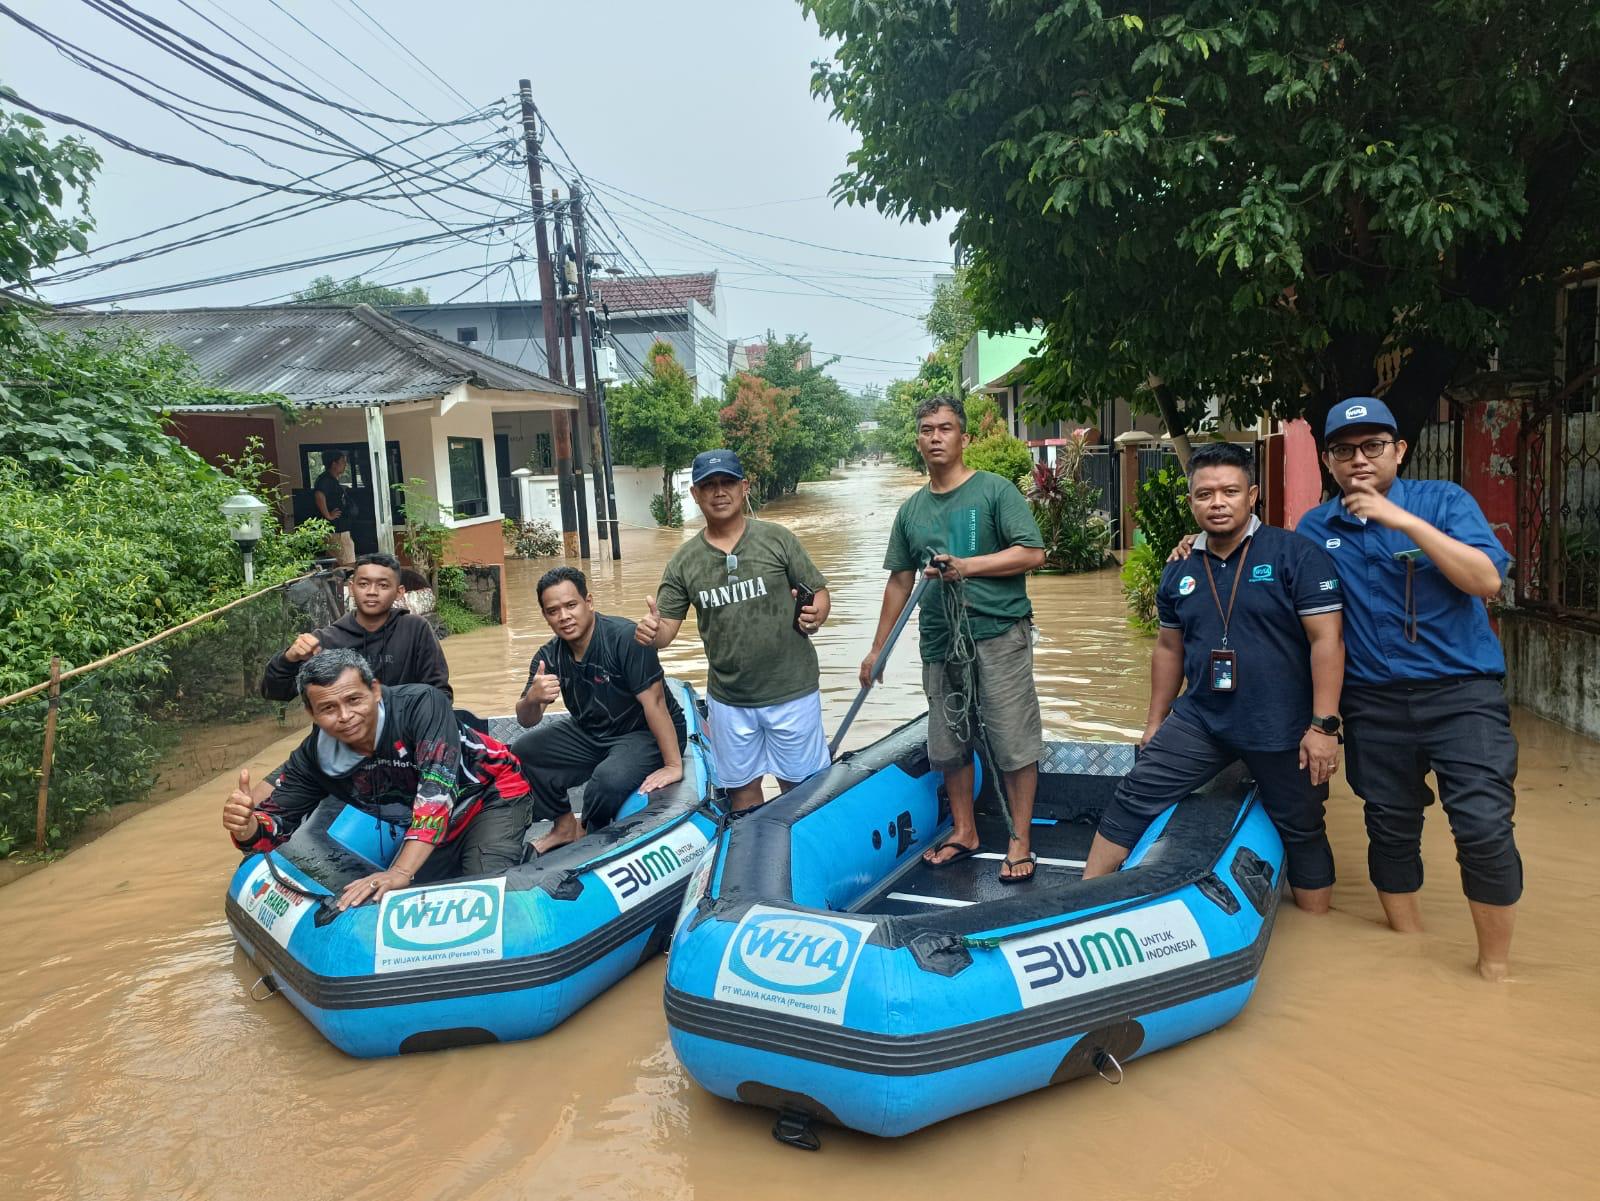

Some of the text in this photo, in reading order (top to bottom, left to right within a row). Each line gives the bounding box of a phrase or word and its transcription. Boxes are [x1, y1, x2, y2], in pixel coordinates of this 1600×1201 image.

[699, 576, 768, 609] PANITIA
[675, 842, 694, 856] UNTUK
[264, 889, 290, 918] SHARED
[1140, 930, 1175, 947] UNTUK
[1146, 938, 1197, 961] INDONESIA
[393, 955, 421, 965] WIJAYA
[422, 952, 447, 962] KARYA
[721, 985, 731, 994] PT
[733, 987, 760, 999] WIJAYA
[761, 992, 786, 1005] KARYA
[787, 998, 821, 1013] (Persero)
